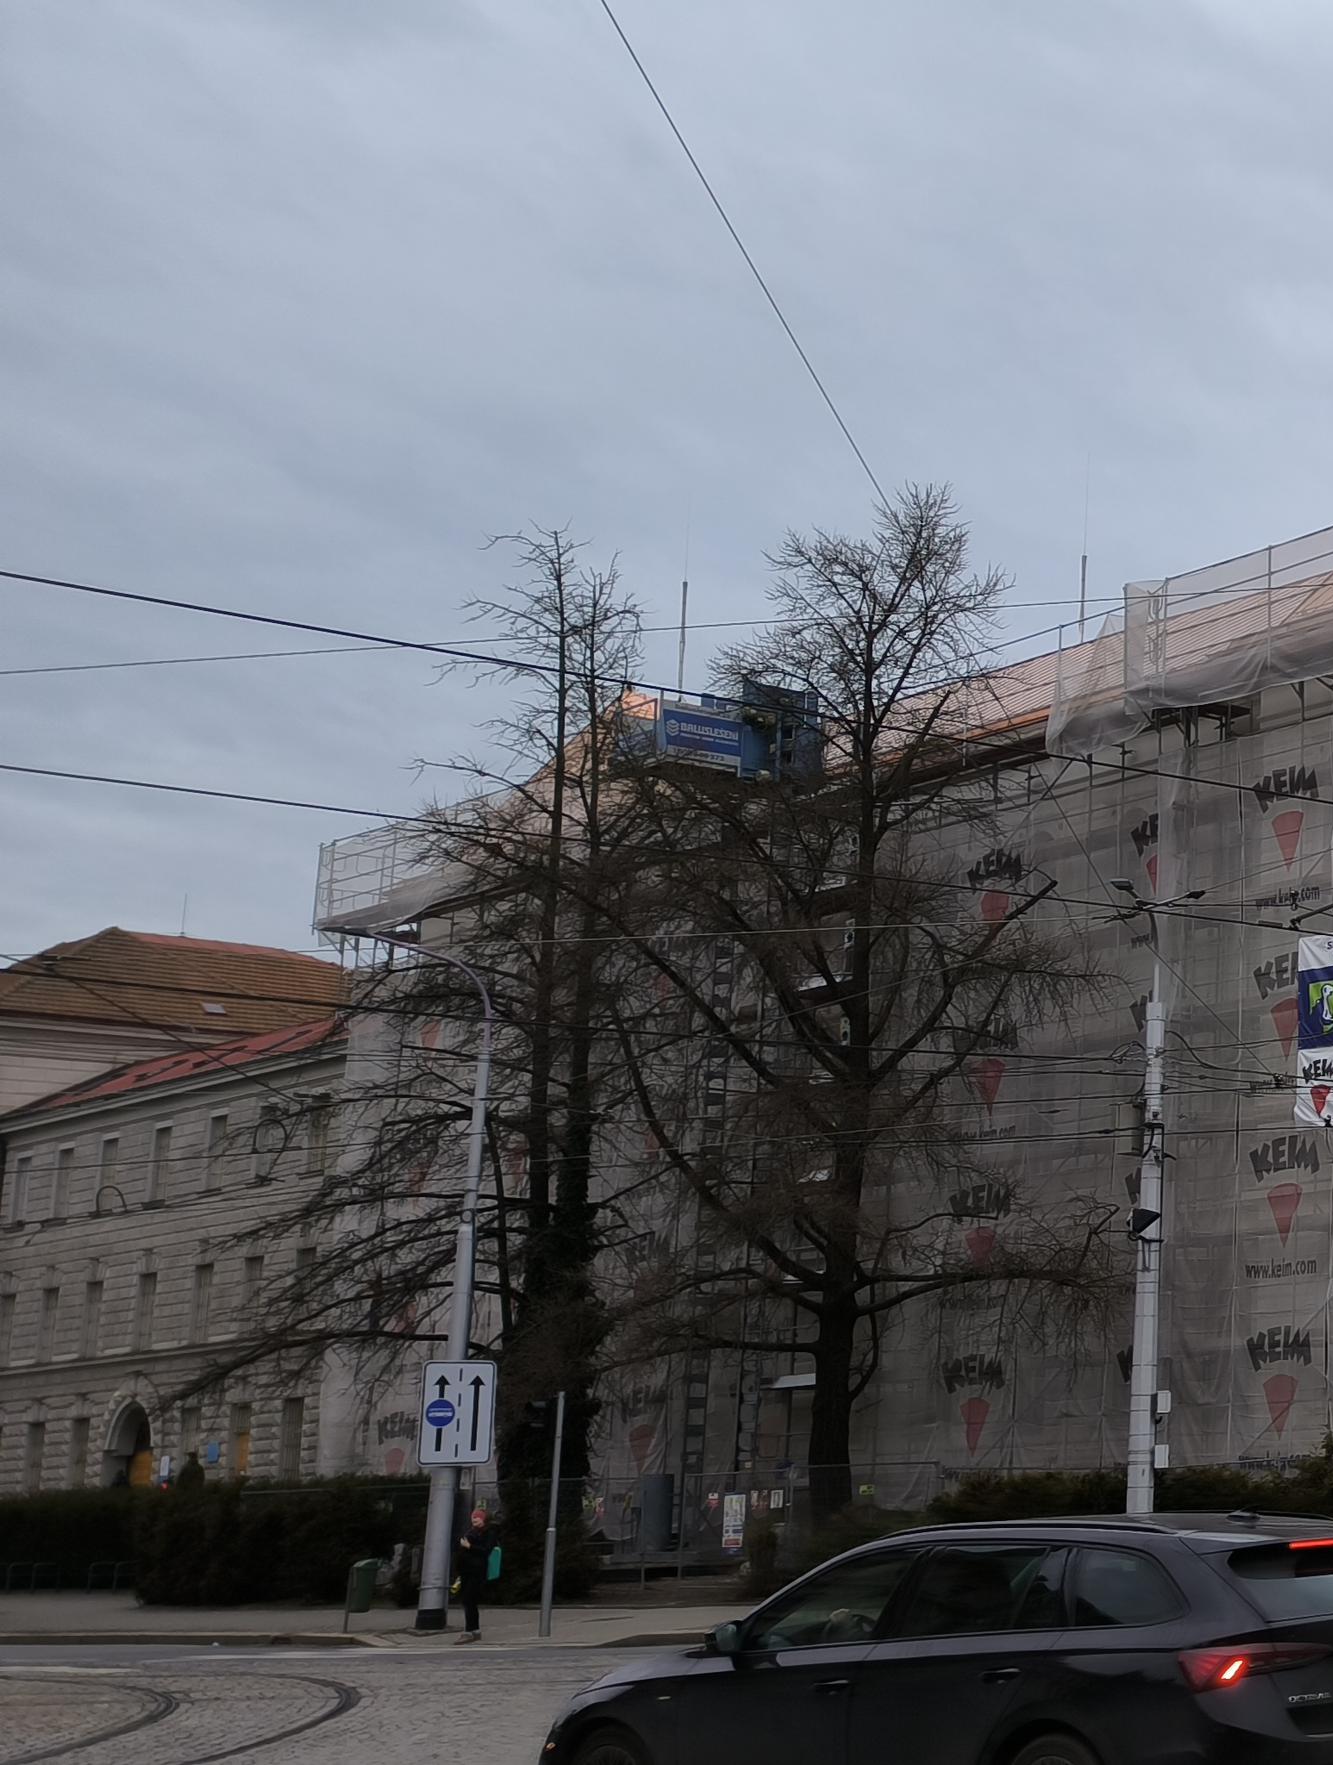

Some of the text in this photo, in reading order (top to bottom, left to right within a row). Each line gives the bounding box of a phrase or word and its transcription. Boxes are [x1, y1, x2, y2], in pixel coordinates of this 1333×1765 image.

[1252, 765, 1319, 814] KEIM
[1130, 813, 1158, 856] KE
[1253, 951, 1298, 1000] KEI
[1249, 1135, 1320, 1182] KEIM
[1245, 1257, 1317, 1281] www.keim.com
[1246, 1325, 1312, 1372] KEIM
